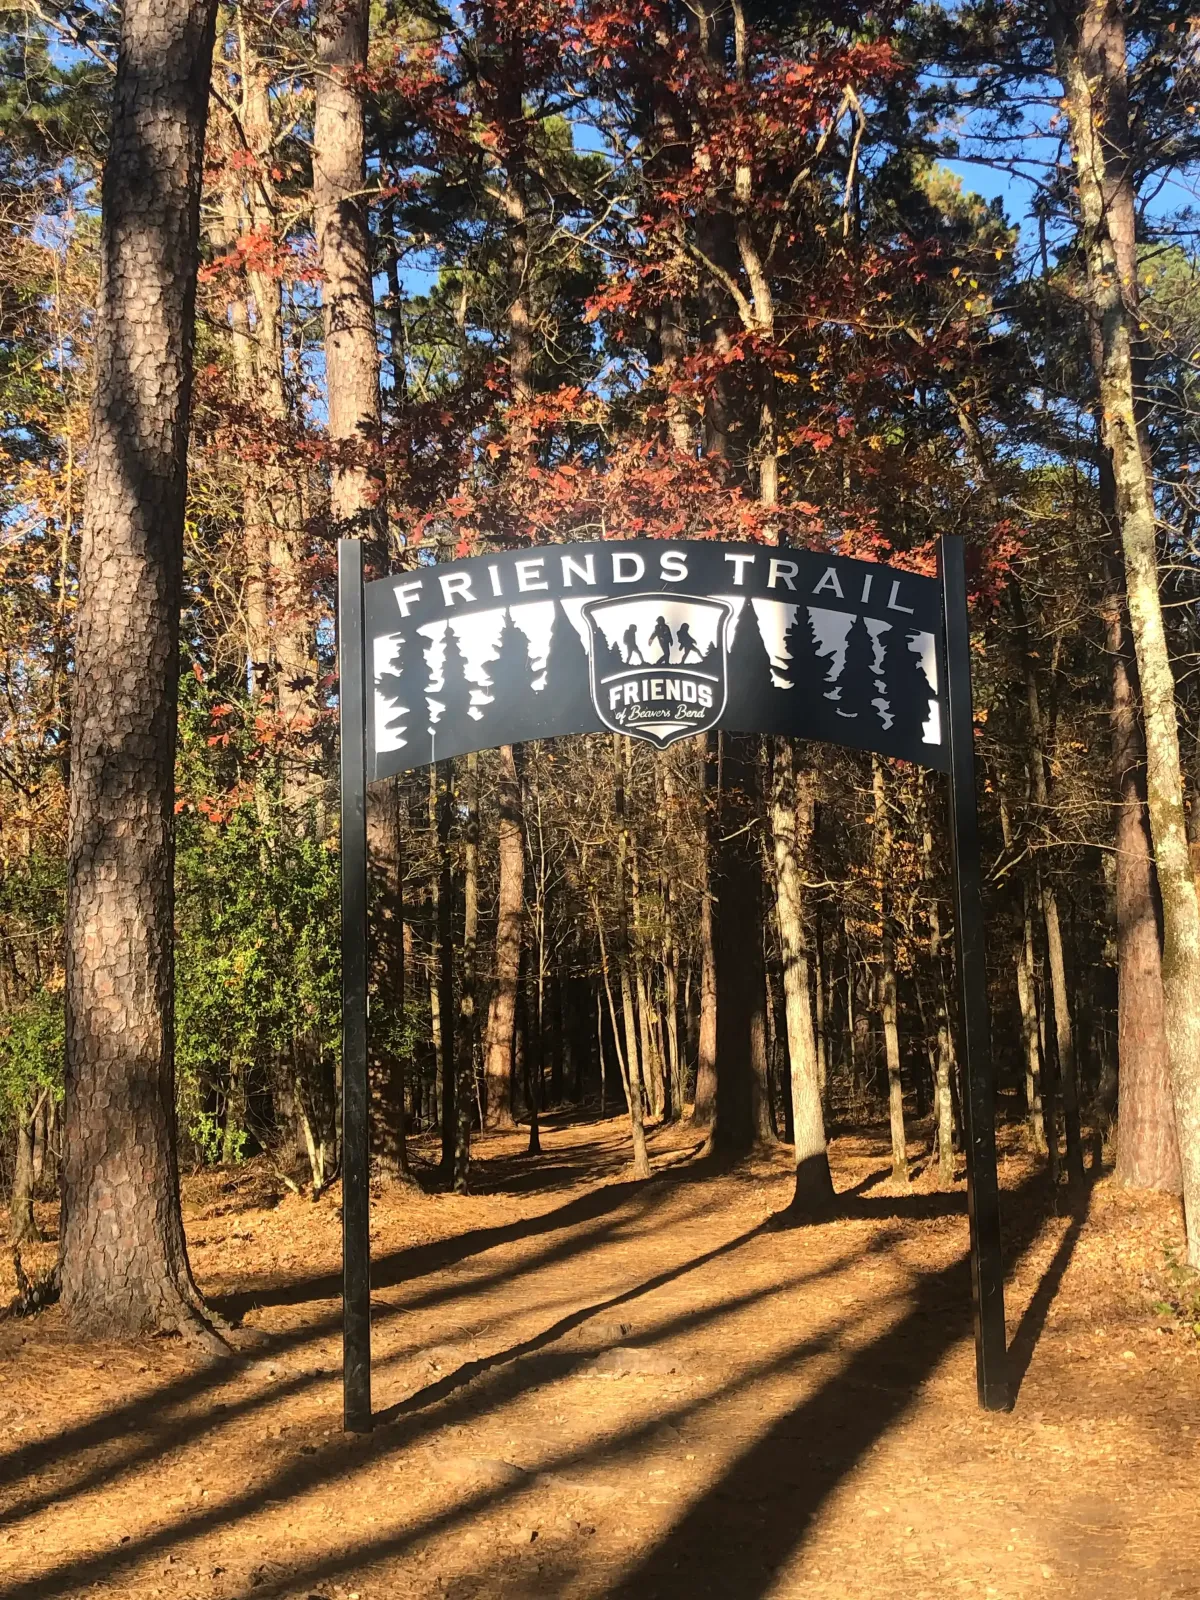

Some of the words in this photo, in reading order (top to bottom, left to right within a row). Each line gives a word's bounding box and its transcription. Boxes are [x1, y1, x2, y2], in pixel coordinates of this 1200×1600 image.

[393, 551, 689, 618] FRIENDS
[724, 554, 915, 614] TRAIL
[609, 679, 713, 710] FRIENDS
[615, 707, 626, 725] of
[674, 703, 706, 719] Bend
